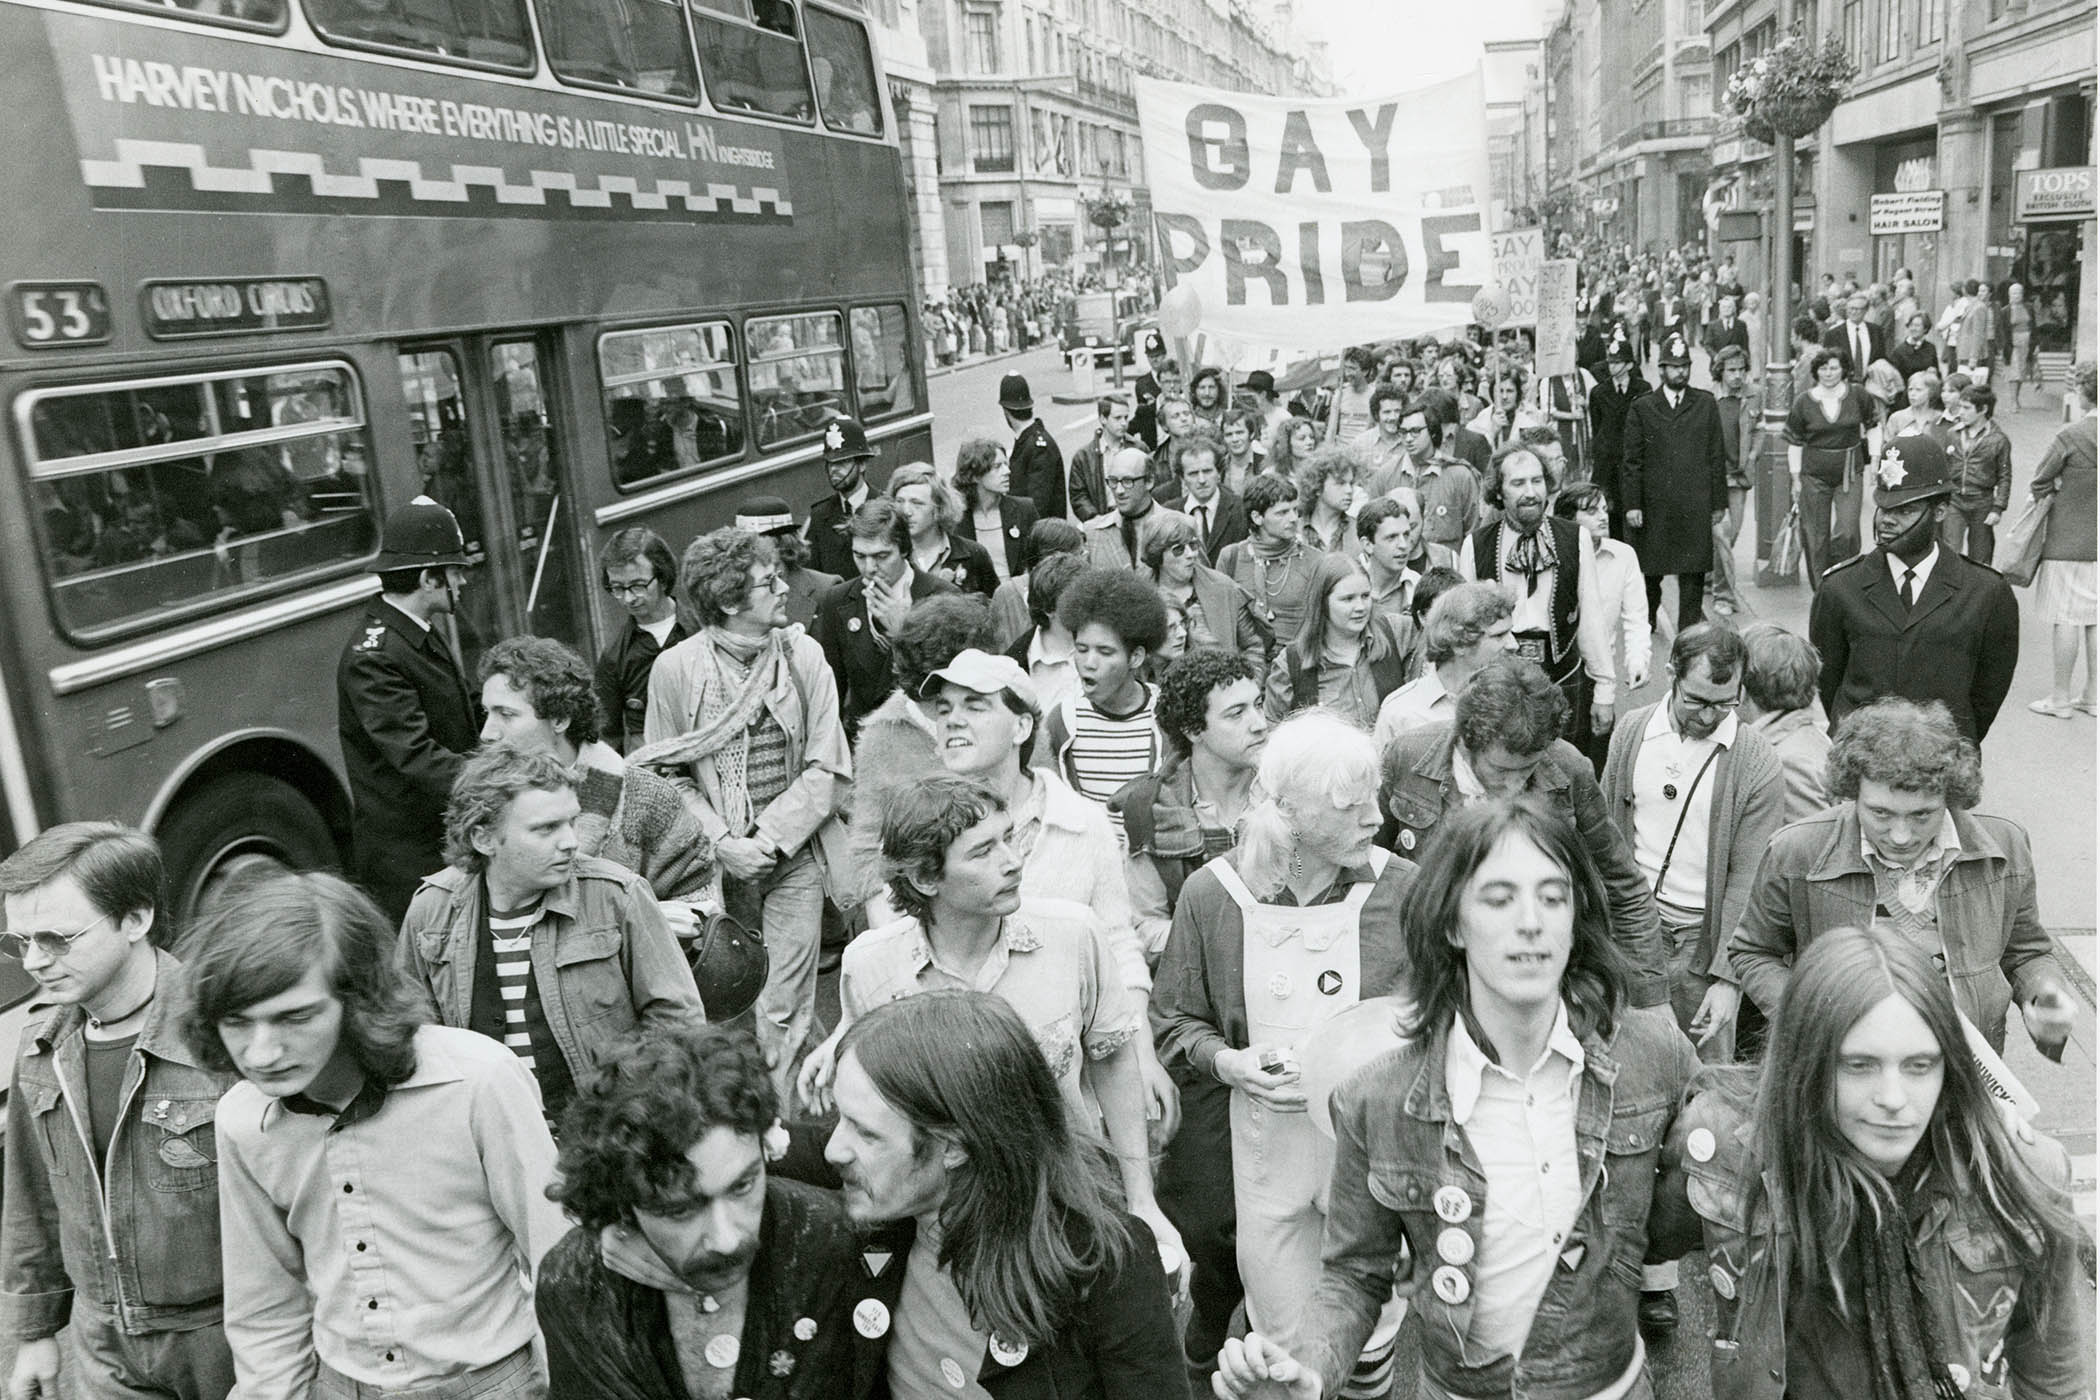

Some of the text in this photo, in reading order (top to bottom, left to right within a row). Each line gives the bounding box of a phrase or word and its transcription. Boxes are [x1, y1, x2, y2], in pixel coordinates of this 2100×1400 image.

[93, 54, 229, 112] HARVEY
[357, 89, 442, 134] WHERE
[441, 101, 558, 147] EVERYTHING
[556, 115, 574, 148] IS
[575, 118, 590, 149] A
[586, 119, 629, 154] LITTLE
[1185, 103, 1399, 194] GAY
[1872, 198, 1904, 206] Robert
[2028, 171, 2091, 193] TOPS
[1874, 218, 1939, 229] HAIR SALON
[1153, 212, 1484, 306] PRIDE
